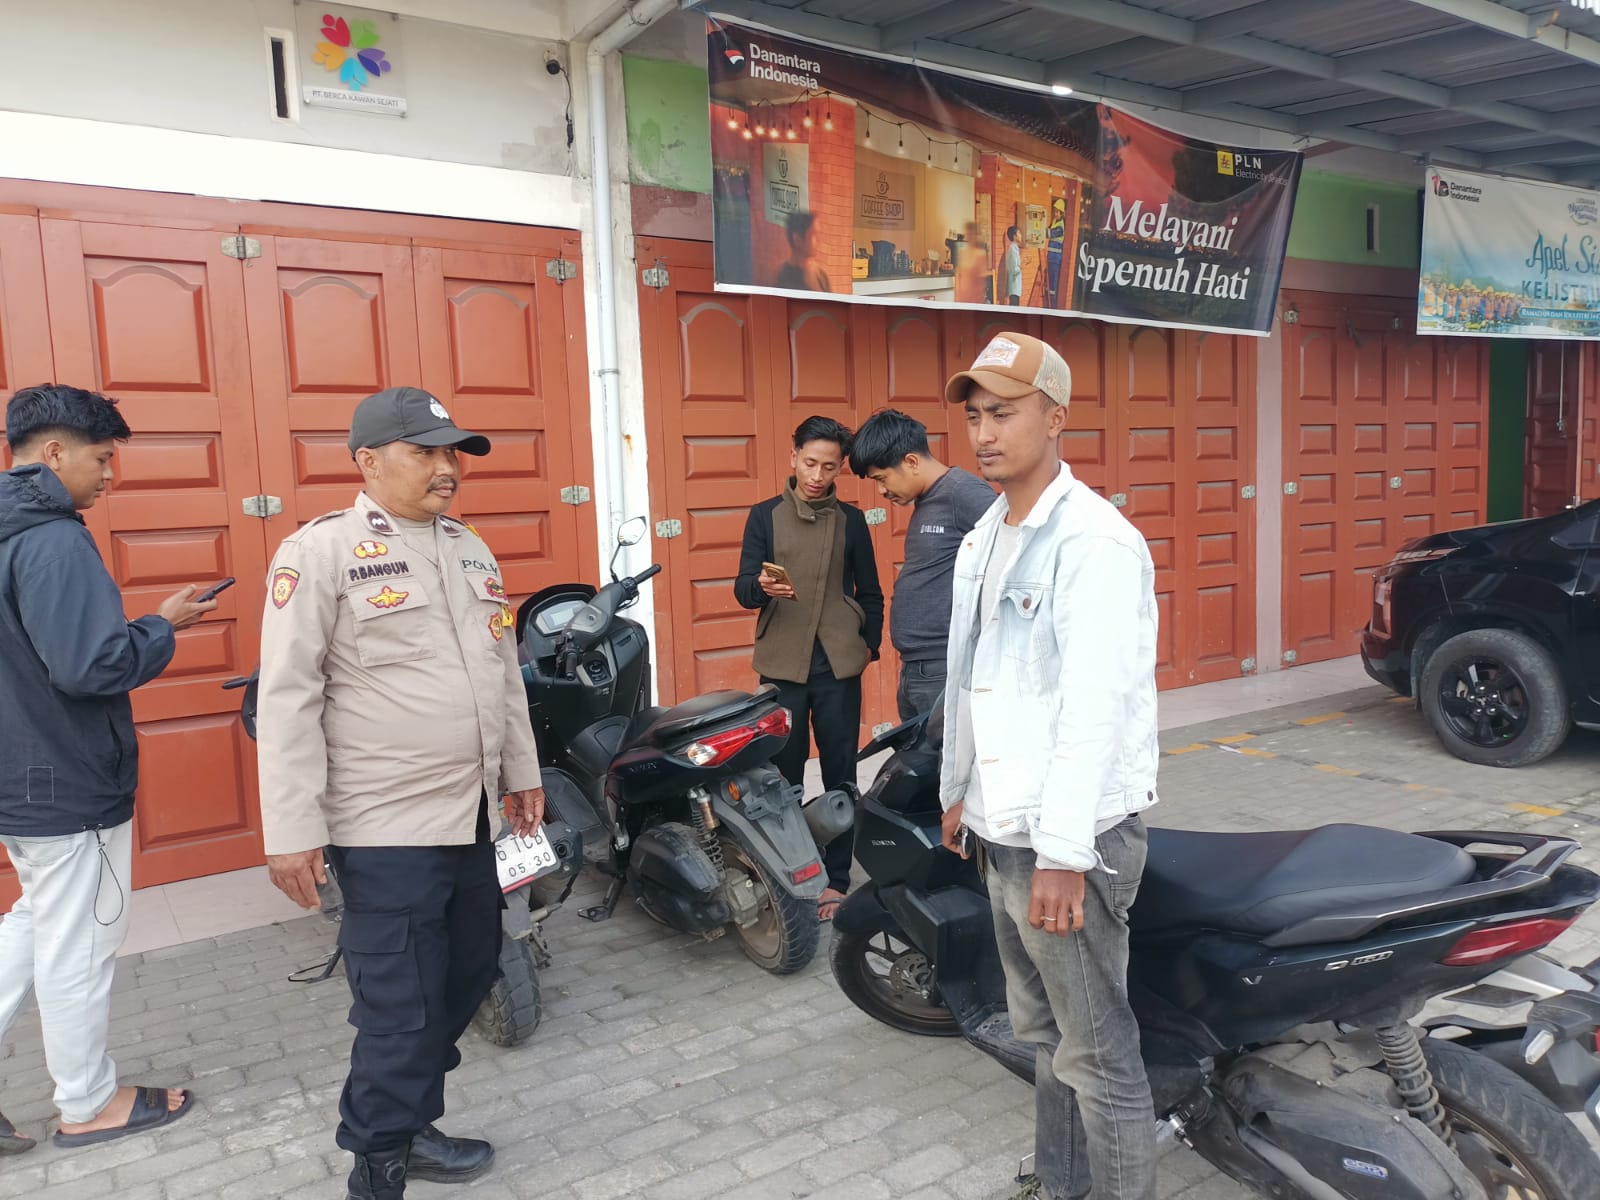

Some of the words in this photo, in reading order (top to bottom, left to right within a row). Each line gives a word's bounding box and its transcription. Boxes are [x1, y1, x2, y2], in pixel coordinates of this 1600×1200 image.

[750, 43, 821, 74] Danantara
[750, 60, 818, 89] Indonesia
[1234, 154, 1262, 169] PLN
[863, 199, 884, 216] COFFEE
[885, 201, 902, 216] SHOP
[1103, 195, 1238, 255] Melayani
[1077, 241, 1189, 294] Sepenuh
[1192, 262, 1250, 301] Hati
[348, 560, 409, 582] P.BANGUN
